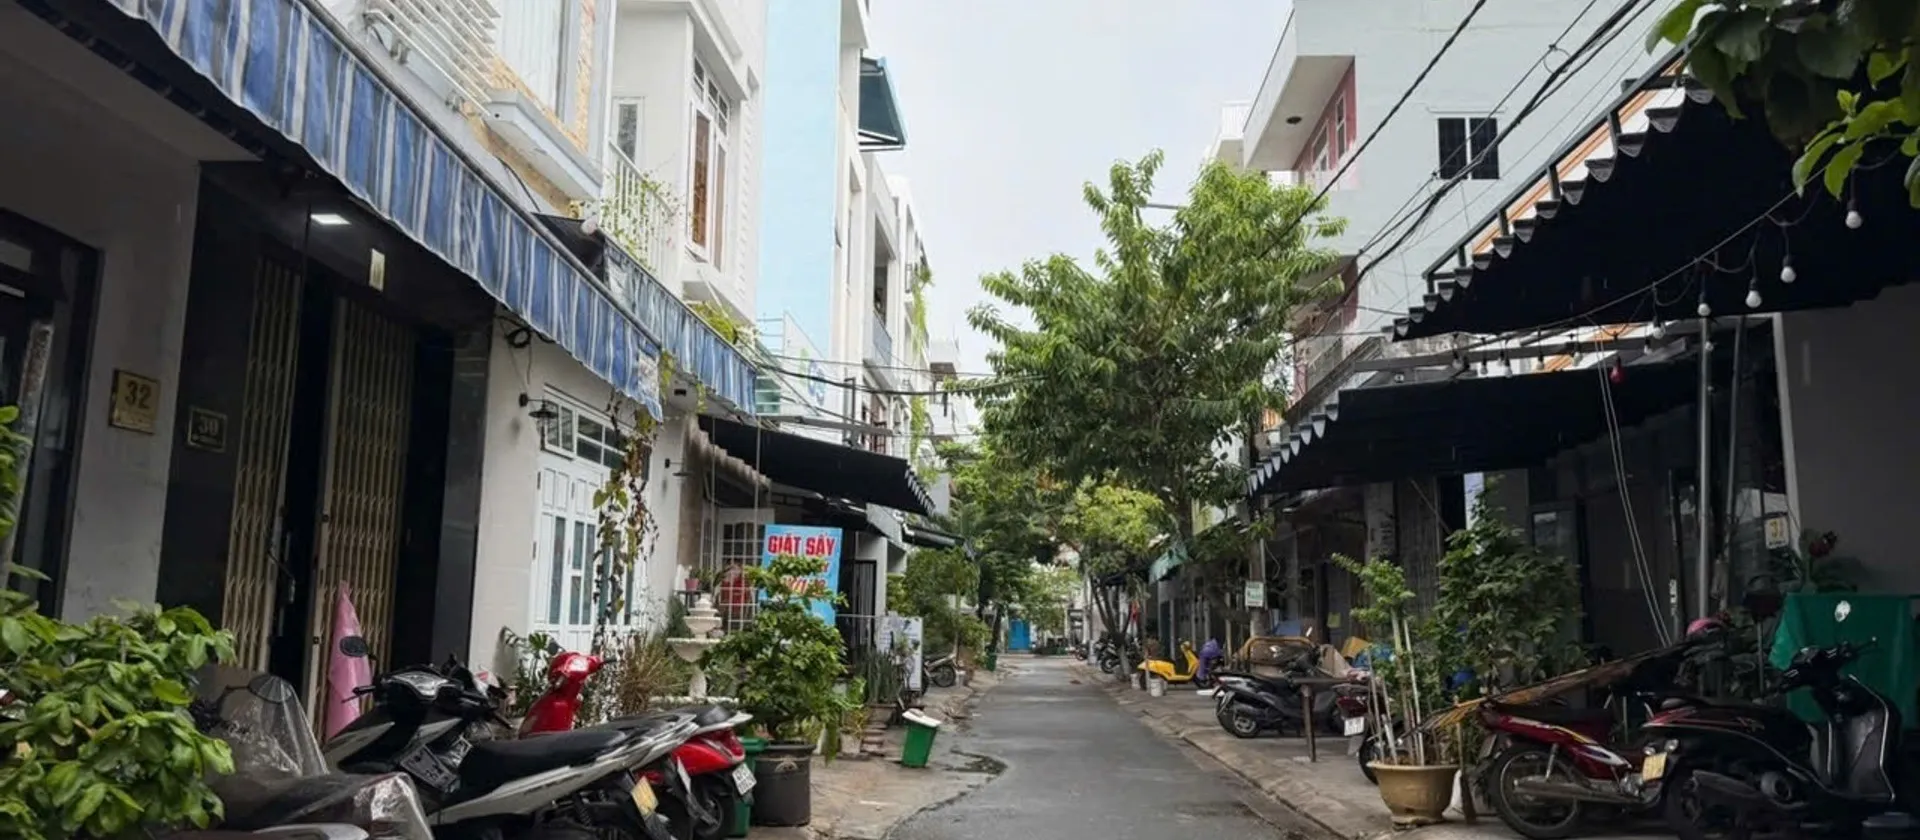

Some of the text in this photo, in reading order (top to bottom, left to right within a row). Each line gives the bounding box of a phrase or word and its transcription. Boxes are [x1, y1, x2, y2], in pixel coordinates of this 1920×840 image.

[125, 379, 152, 409] 32
[198, 416, 220, 436] 30
[806, 532, 836, 556] SẤY
